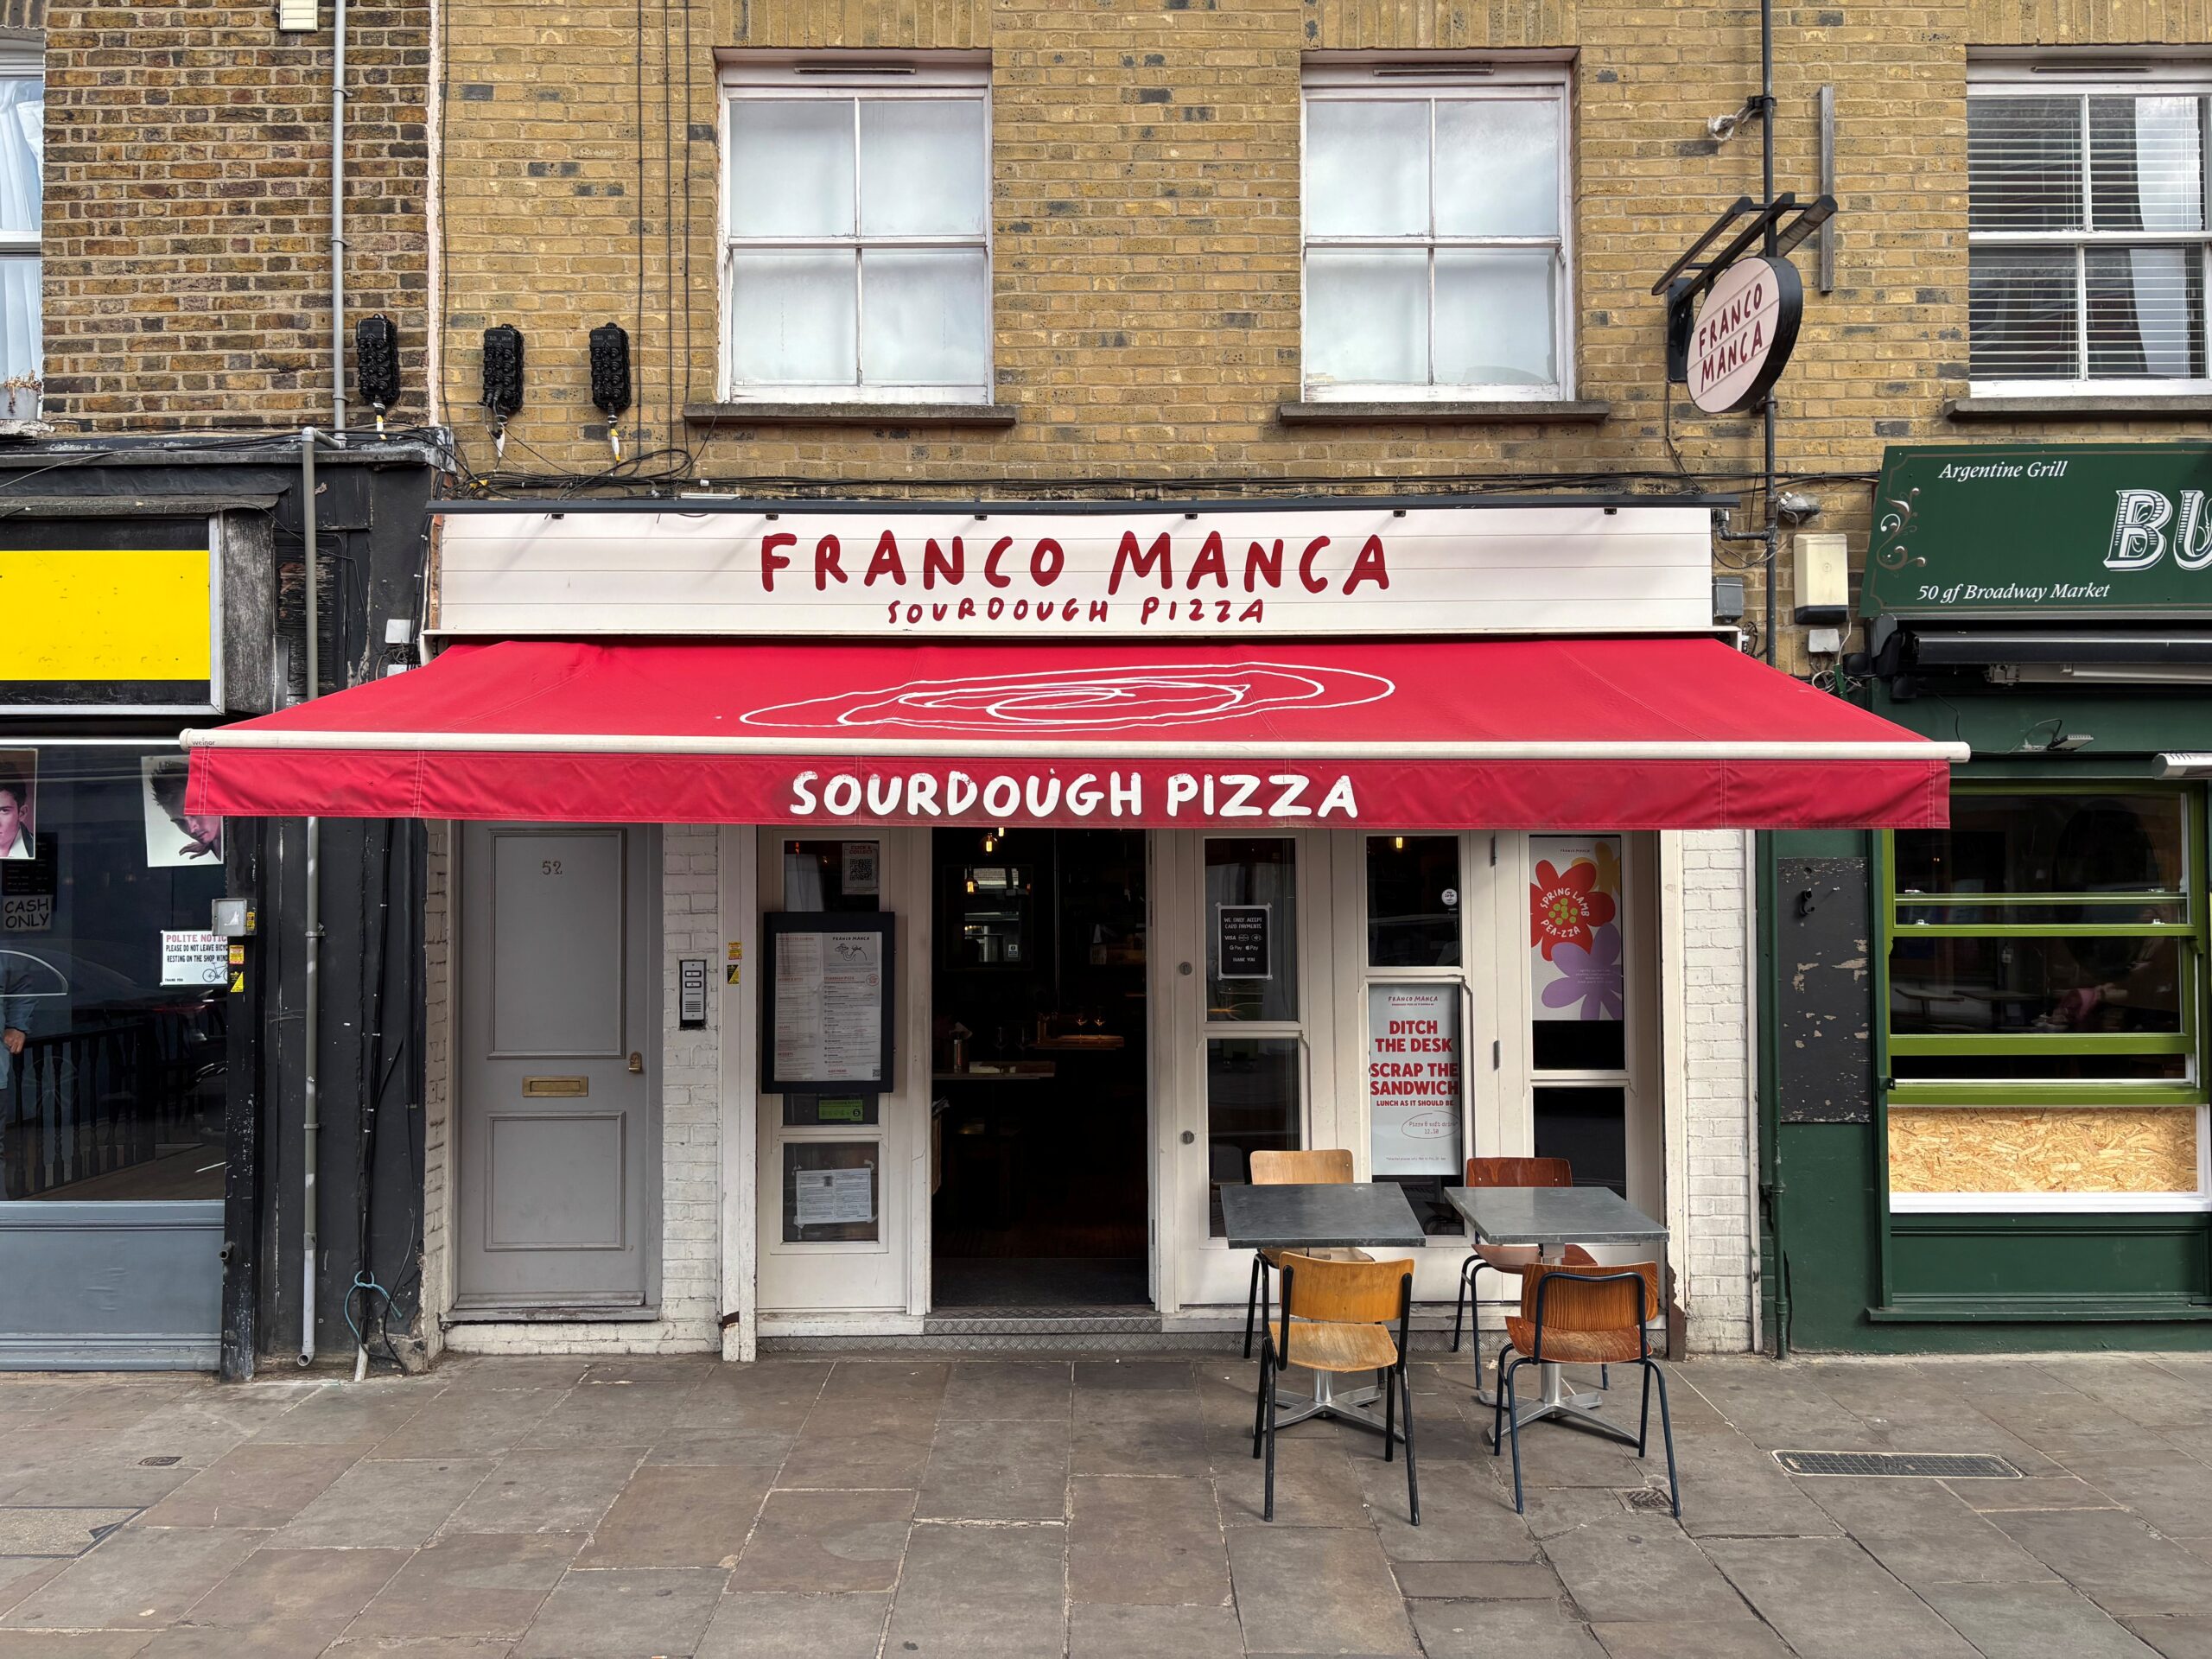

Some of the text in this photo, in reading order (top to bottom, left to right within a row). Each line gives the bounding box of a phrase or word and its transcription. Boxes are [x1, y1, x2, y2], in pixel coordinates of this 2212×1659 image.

[1699, 283, 1763, 358] FRANCO
[1700, 320, 1763, 392] MANCA
[1938, 460, 2069, 483] Argentine Grill
[760, 529, 1390, 597] FRANCO MANCA
[1916, 584, 1938, 601] 50
[1964, 583, 2047, 601] Broadway
[2050, 582, 2111, 599] Market
[888, 596, 1264, 625] SOURDOUGH PIZZA
[789, 771, 1359, 818] SOURDOUGH PIZZA
[541, 861, 563, 875] 52
[4, 898, 49, 913] CASH
[1540, 888, 1590, 917] SPRING LAMB
[5, 912, 49, 929] ONLY
[1541, 919, 1581, 938] PEA-ZZA
[1389, 1020, 1438, 1035] DITCH
[1375, 1038, 1453, 1052] THE DESK
[1370, 1063, 1459, 1077] SCRAP THE
[1370, 1080, 1459, 1096] SANDWICH
